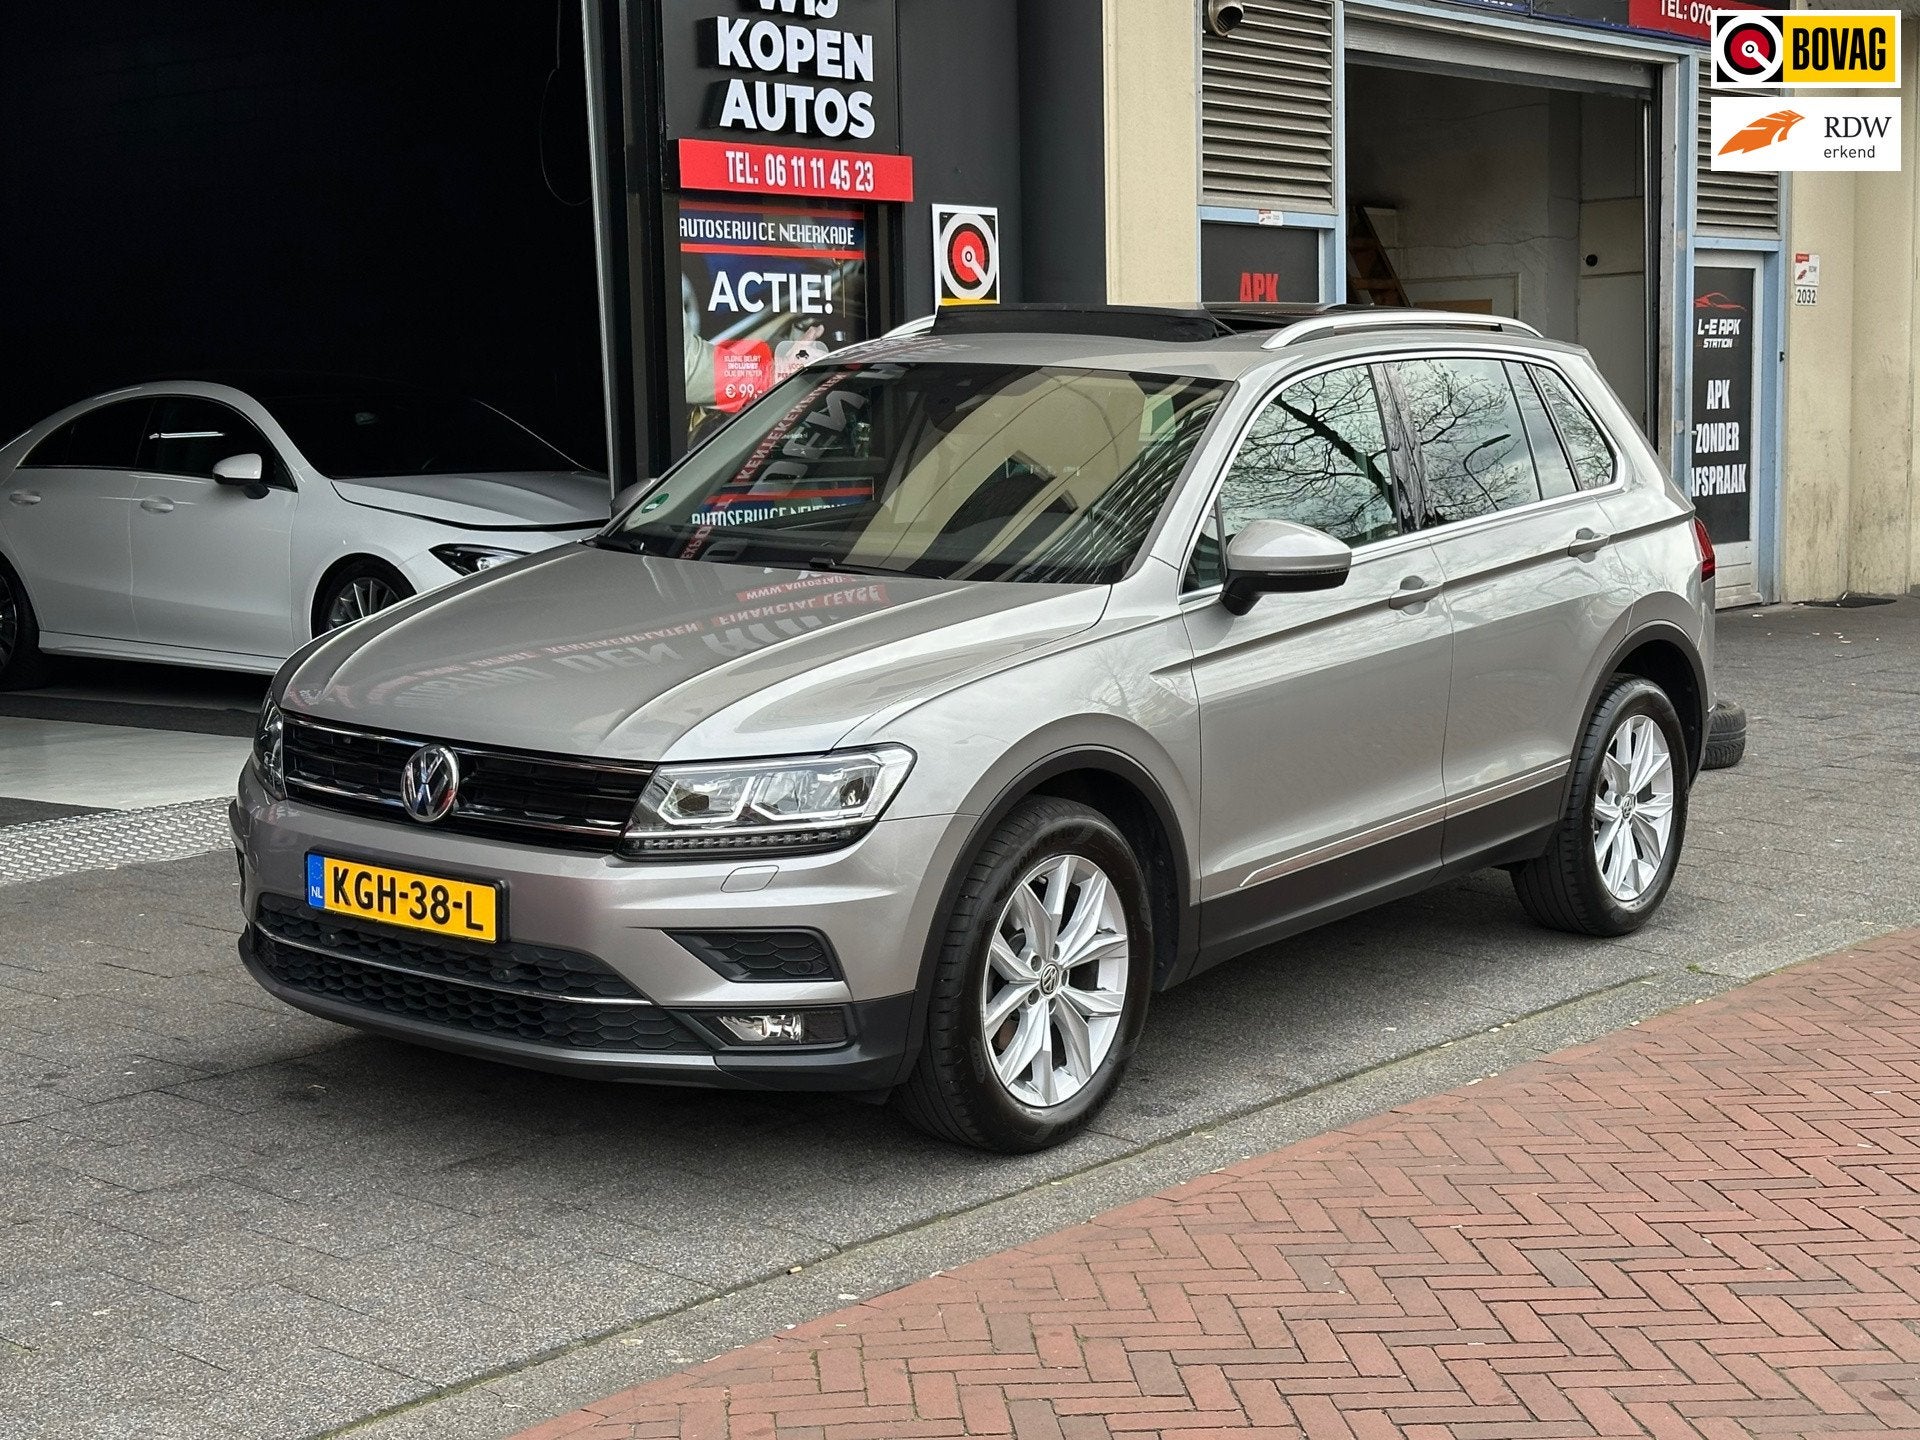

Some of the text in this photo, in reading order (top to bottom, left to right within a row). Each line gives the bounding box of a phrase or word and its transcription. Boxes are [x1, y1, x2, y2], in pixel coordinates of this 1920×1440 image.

[717, 16, 873, 82] KOPEN
[719, 79, 875, 139] AUTOS
[726, 151, 874, 192] TEL: 06 11 11 45 23
[680, 218, 855, 245] AUTOSERVICE NEHERKADE
[707, 271, 833, 314] ACTIE!
[1239, 272, 1279, 303] APK
[1797, 289, 1816, 303] 2032
[1718, 318, 1741, 335] APK
[1703, 338, 1733, 348] STATION
[725, 383, 737, 399] €
[1706, 380, 1730, 410] APK
[1695, 422, 1740, 453] ZONDER
[311, 866, 484, 932] NL KGH-38-L
